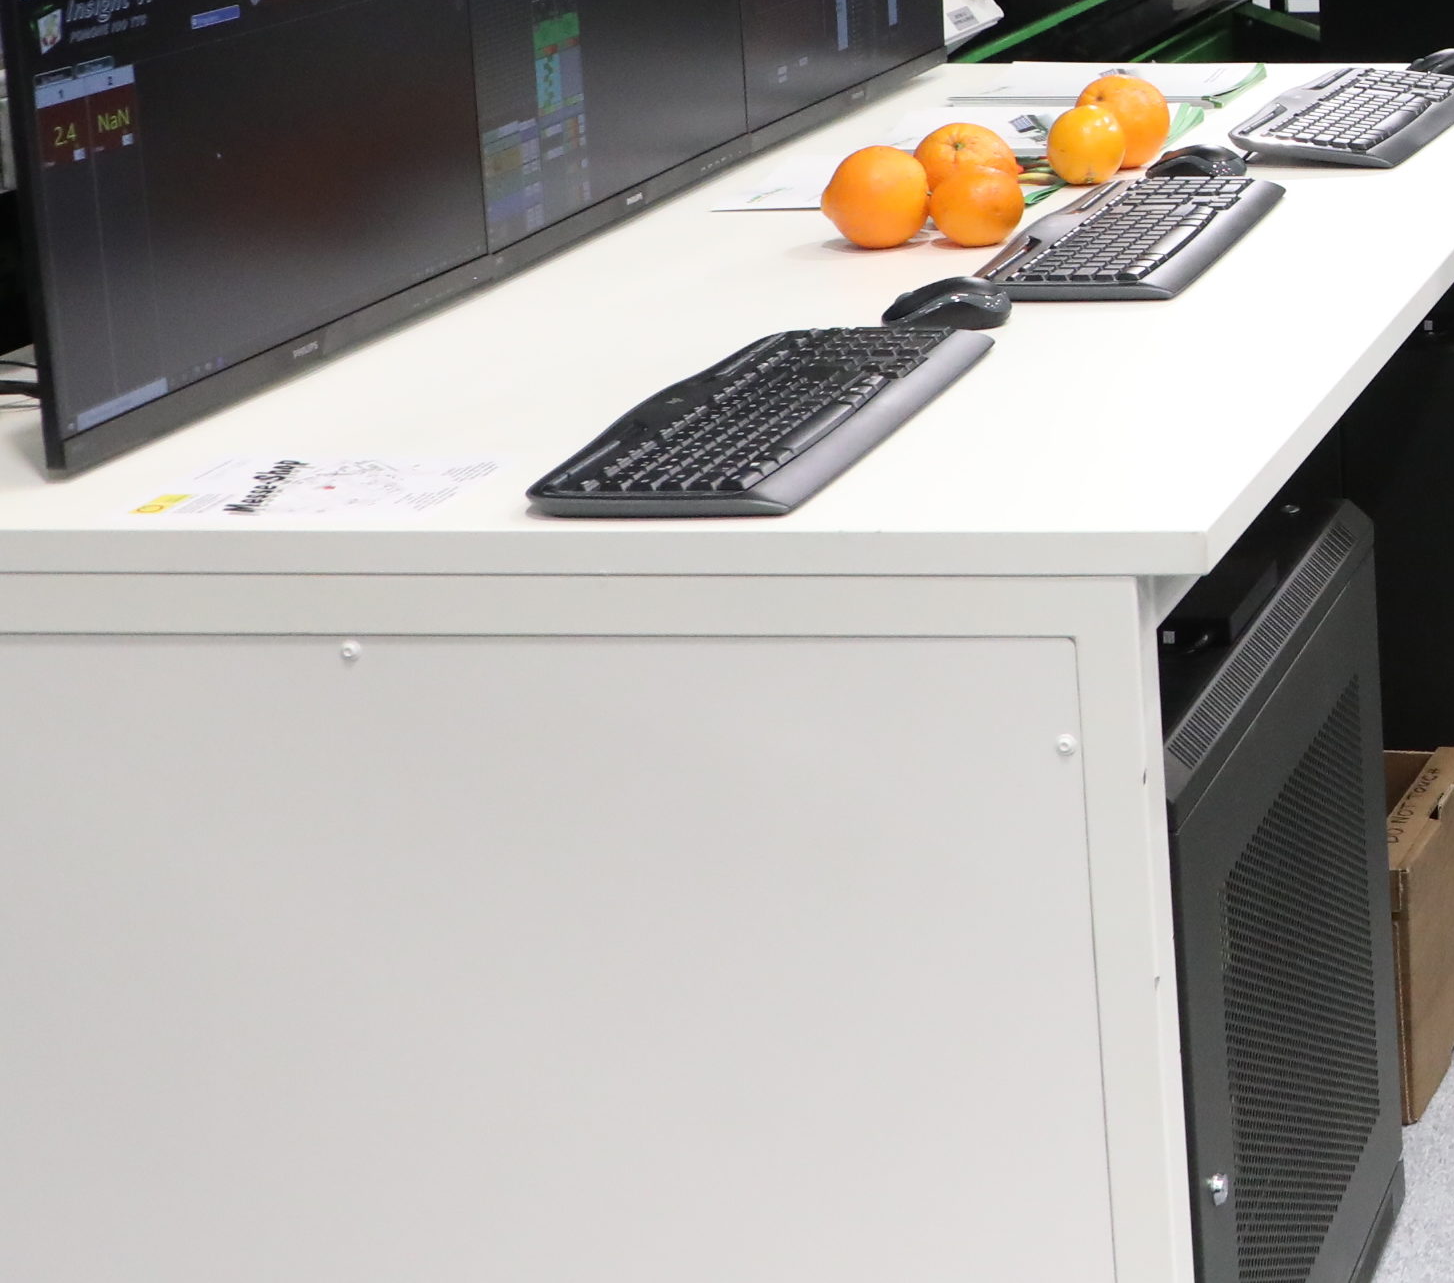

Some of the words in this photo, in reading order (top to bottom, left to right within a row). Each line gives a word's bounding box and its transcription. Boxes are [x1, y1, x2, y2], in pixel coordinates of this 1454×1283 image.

[97, 106, 130, 133] NaN
[223, 460, 309, 513] Messe-Shop
[1390, 801, 1416, 824] NOT
